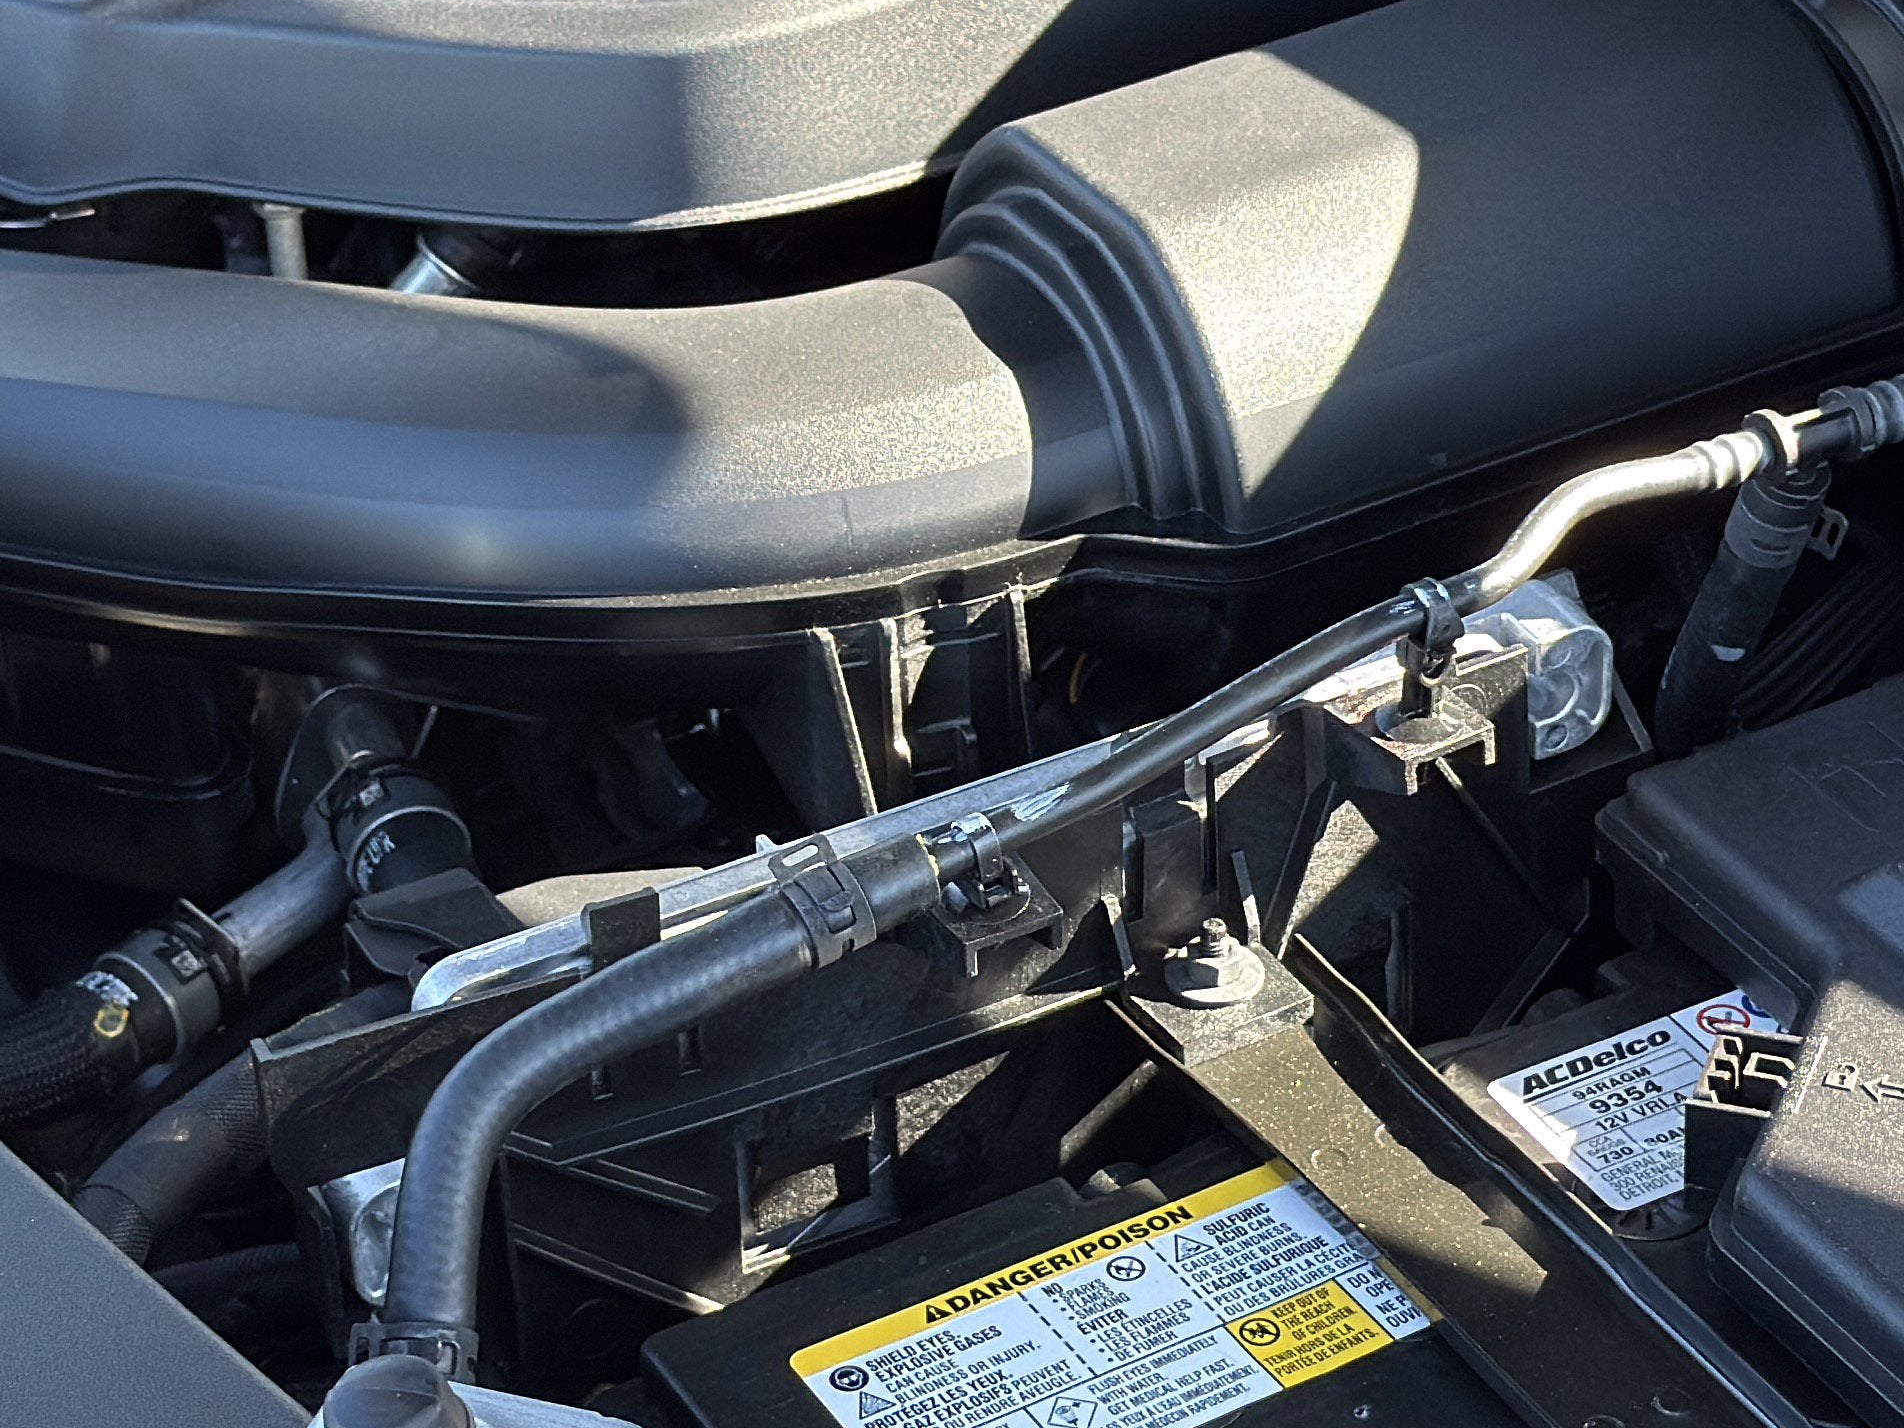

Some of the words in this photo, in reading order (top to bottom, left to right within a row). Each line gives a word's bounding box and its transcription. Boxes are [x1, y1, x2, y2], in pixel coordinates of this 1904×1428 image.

[1523, 1030, 1671, 1096] ACDelco
[1572, 1066, 1651, 1100] 94RAGM
[1589, 1080, 1663, 1113] 9354
[1595, 1112, 1629, 1131] 12V
[1597, 1146, 1634, 1164] 730
[1601, 1155, 1661, 1182] GENERAL
[1609, 1177, 1636, 1192] 300
[1619, 1173, 1679, 1201] DETROIT,
[1203, 1203, 1270, 1235] SULFURIC
[1215, 1226, 1248, 1246] ACID
[1248, 1215, 1276, 1231] CAN
[945, 1205, 1193, 1313] DANGER/POISON
[1181, 1251, 1224, 1273] CAUSE
[1222, 1222, 1292, 1256] BLINDNESS
[1191, 1270, 1212, 1283] OR
[1211, 1250, 1260, 1275] SEVERE
[1258, 1232, 1307, 1255] BURNS.
[1200, 1268, 1252, 1295] L'ACIDE
[1249, 1236, 1329, 1275] SULFURIQUE
[1347, 1273, 1370, 1288] DO
[1041, 1283, 1063, 1297] NO
[1058, 1278, 1106, 1303] SPARKS
[1066, 1287, 1115, 1311] FLAMES
[1213, 1287, 1247, 1306] PEUT
[1247, 1266, 1298, 1292] CAUSER
[1295, 1259, 1316, 1271] LA
[1075, 1292, 1131, 1319] SMOKING
[1224, 1302, 1245, 1316] OU
[1243, 1292, 1271, 1308] DES
[1270, 1302, 1296, 1319] KEEP
[1295, 1293, 1317, 1308] OUT
[1315, 1287, 1329, 1299] OF
[1280, 1315, 1304, 1330] THE
[1300, 1300, 1335, 1321] REACH
[1375, 1299, 1399, 1315] NE
[1097, 1327, 1123, 1343] LES
[1104, 1336, 1131, 1352] LES
[1129, 1312, 1190, 1342] FLAMMES
[1291, 1328, 1306, 1341] OF
[1305, 1306, 1358, 1335] CHILDREN.
[865, 1346, 917, 1372] SHIELD
[915, 1330, 961, 1352] EYES.
[874, 1345, 955, 1383] EXPLOSIVE
[953, 1325, 1002, 1351] GASES
[1114, 1348, 1134, 1361] DE
[1132, 1331, 1178, 1354] FUMER
[1263, 1349, 1297, 1367] TENIR
[1294, 1337, 1325, 1355] HORS
[1322, 1330, 1340, 1342] DE
[1336, 1323, 1355, 1336] LA
[1313, 1349, 1331, 1362] DE
[1327, 1328, 1379, 1355] ENFANTS.
[885, 1376, 915, 1393] CAN
[914, 1358, 959, 1381] CAUSE
[894, 1369, 968, 1404] BLINDNESS
[968, 1361, 990, 1374] OR
[987, 1340, 1040, 1366] INJURY.
[1087, 1374, 1125, 1395] FLUSH
[1122, 1363, 1151, 1380] EYES
[1149, 1335, 1218, 1369] IMMEDIATELY
[933, 1384, 1012, 1422] EXPLOSIFS
[1011, 1359, 1070, 1390] PEUVENT
[938, 1386, 968, 1404] LES
[966, 1369, 1013, 1391] YEUX.
[964, 1396, 1019, 1423] RENDRE
[1019, 1371, 1082, 1402] AVEUGLE.
[1097, 1387, 1128, 1404] WITH
[1125, 1373, 1169, 1393] WATER.
[1107, 1401, 1130, 1415] GET
[1130, 1383, 1178, 1407] MEDICAL
[1174, 1370, 1202, 1388] HELP
[1202, 1358, 1234, 1376] FAST.
[1119, 1410, 1148, 1427] YEUX
